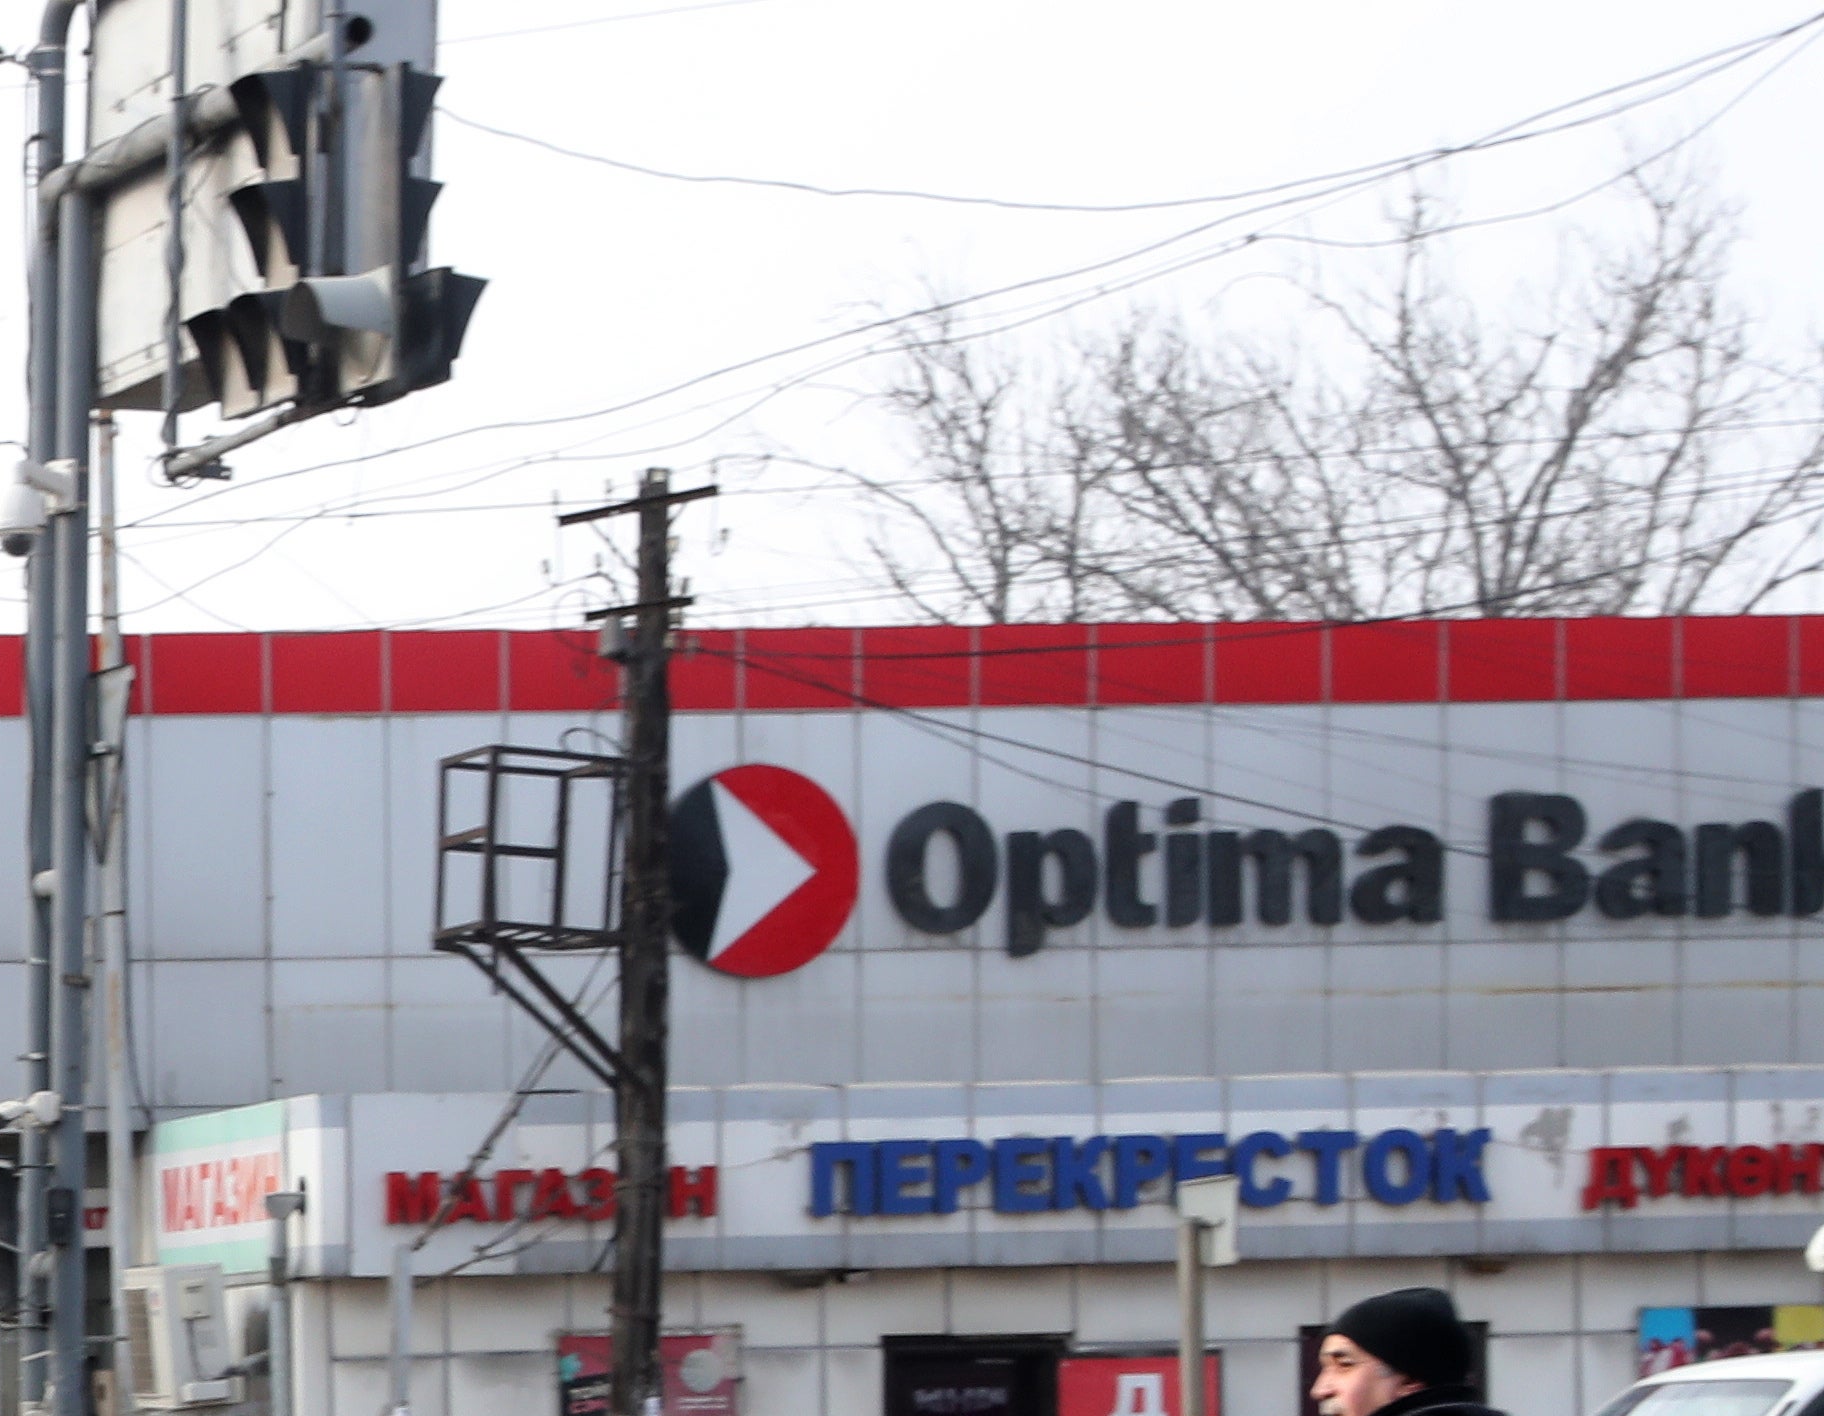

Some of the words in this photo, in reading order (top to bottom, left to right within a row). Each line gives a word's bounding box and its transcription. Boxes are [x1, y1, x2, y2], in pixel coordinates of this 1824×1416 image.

[886, 796, 1445, 959] Optima
[385, 1165, 719, 1225] МАГАЗН
[810, 1127, 1494, 1217] ПЕРЕКРЕСТОК
